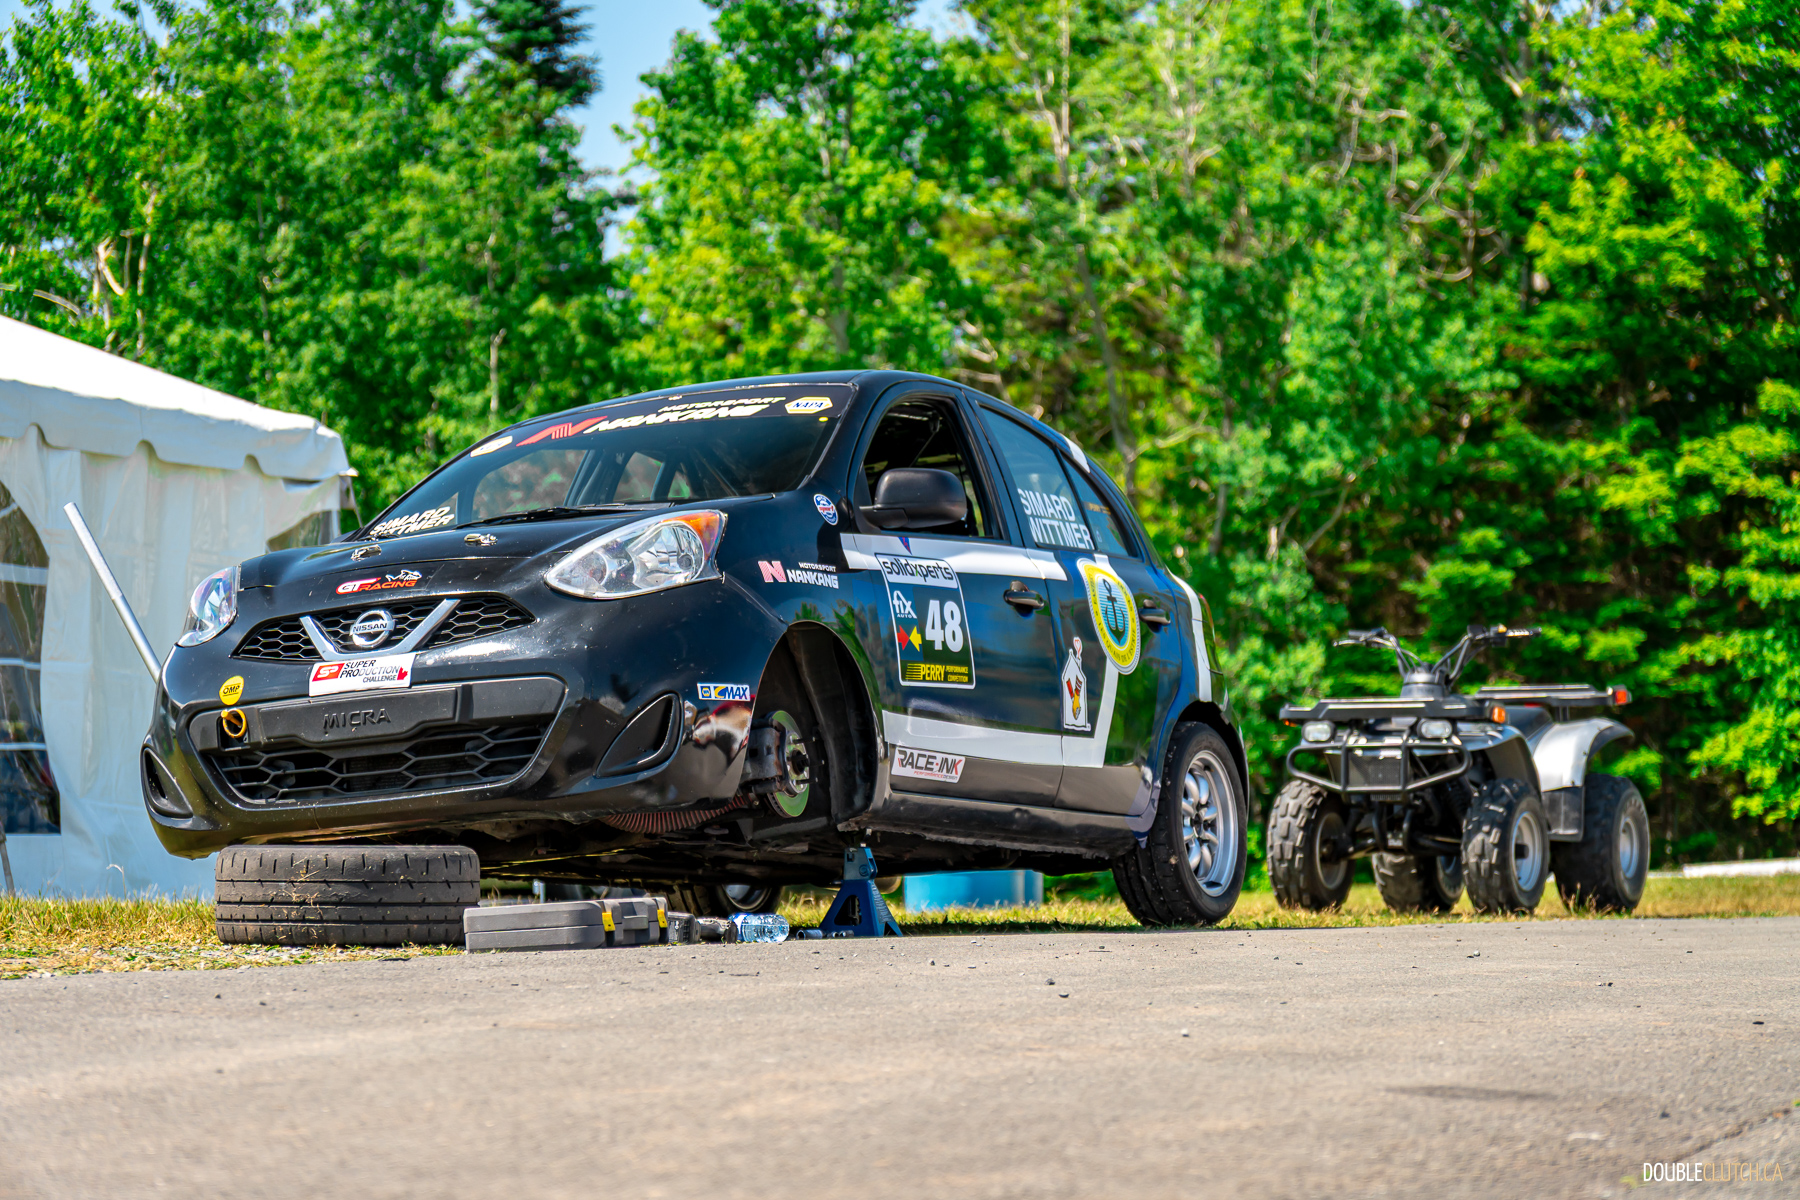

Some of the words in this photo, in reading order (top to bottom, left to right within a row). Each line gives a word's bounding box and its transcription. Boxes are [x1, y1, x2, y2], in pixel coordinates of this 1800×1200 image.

[793, 401, 824, 409] NAPA
[1017, 488, 1076, 522] SIMARD
[370, 506, 451, 535] SIMARD
[376, 514, 455, 535] ITTMER
[1028, 516, 1096, 550] WITTMER
[798, 562, 837, 572] MOTORSPORT
[359, 580, 417, 592] RACING
[786, 568, 839, 589] NANKANG
[352, 622, 388, 633] NISSAN
[925, 599, 964, 653] 48
[344, 660, 376, 669] SUPER
[340, 666, 400, 679] PRODUCTION
[363, 675, 397, 683] CHALLENGE
[920, 664, 945, 681] PERRY
[223, 685, 240, 694] OMP
[323, 708, 391, 729] MICRA
